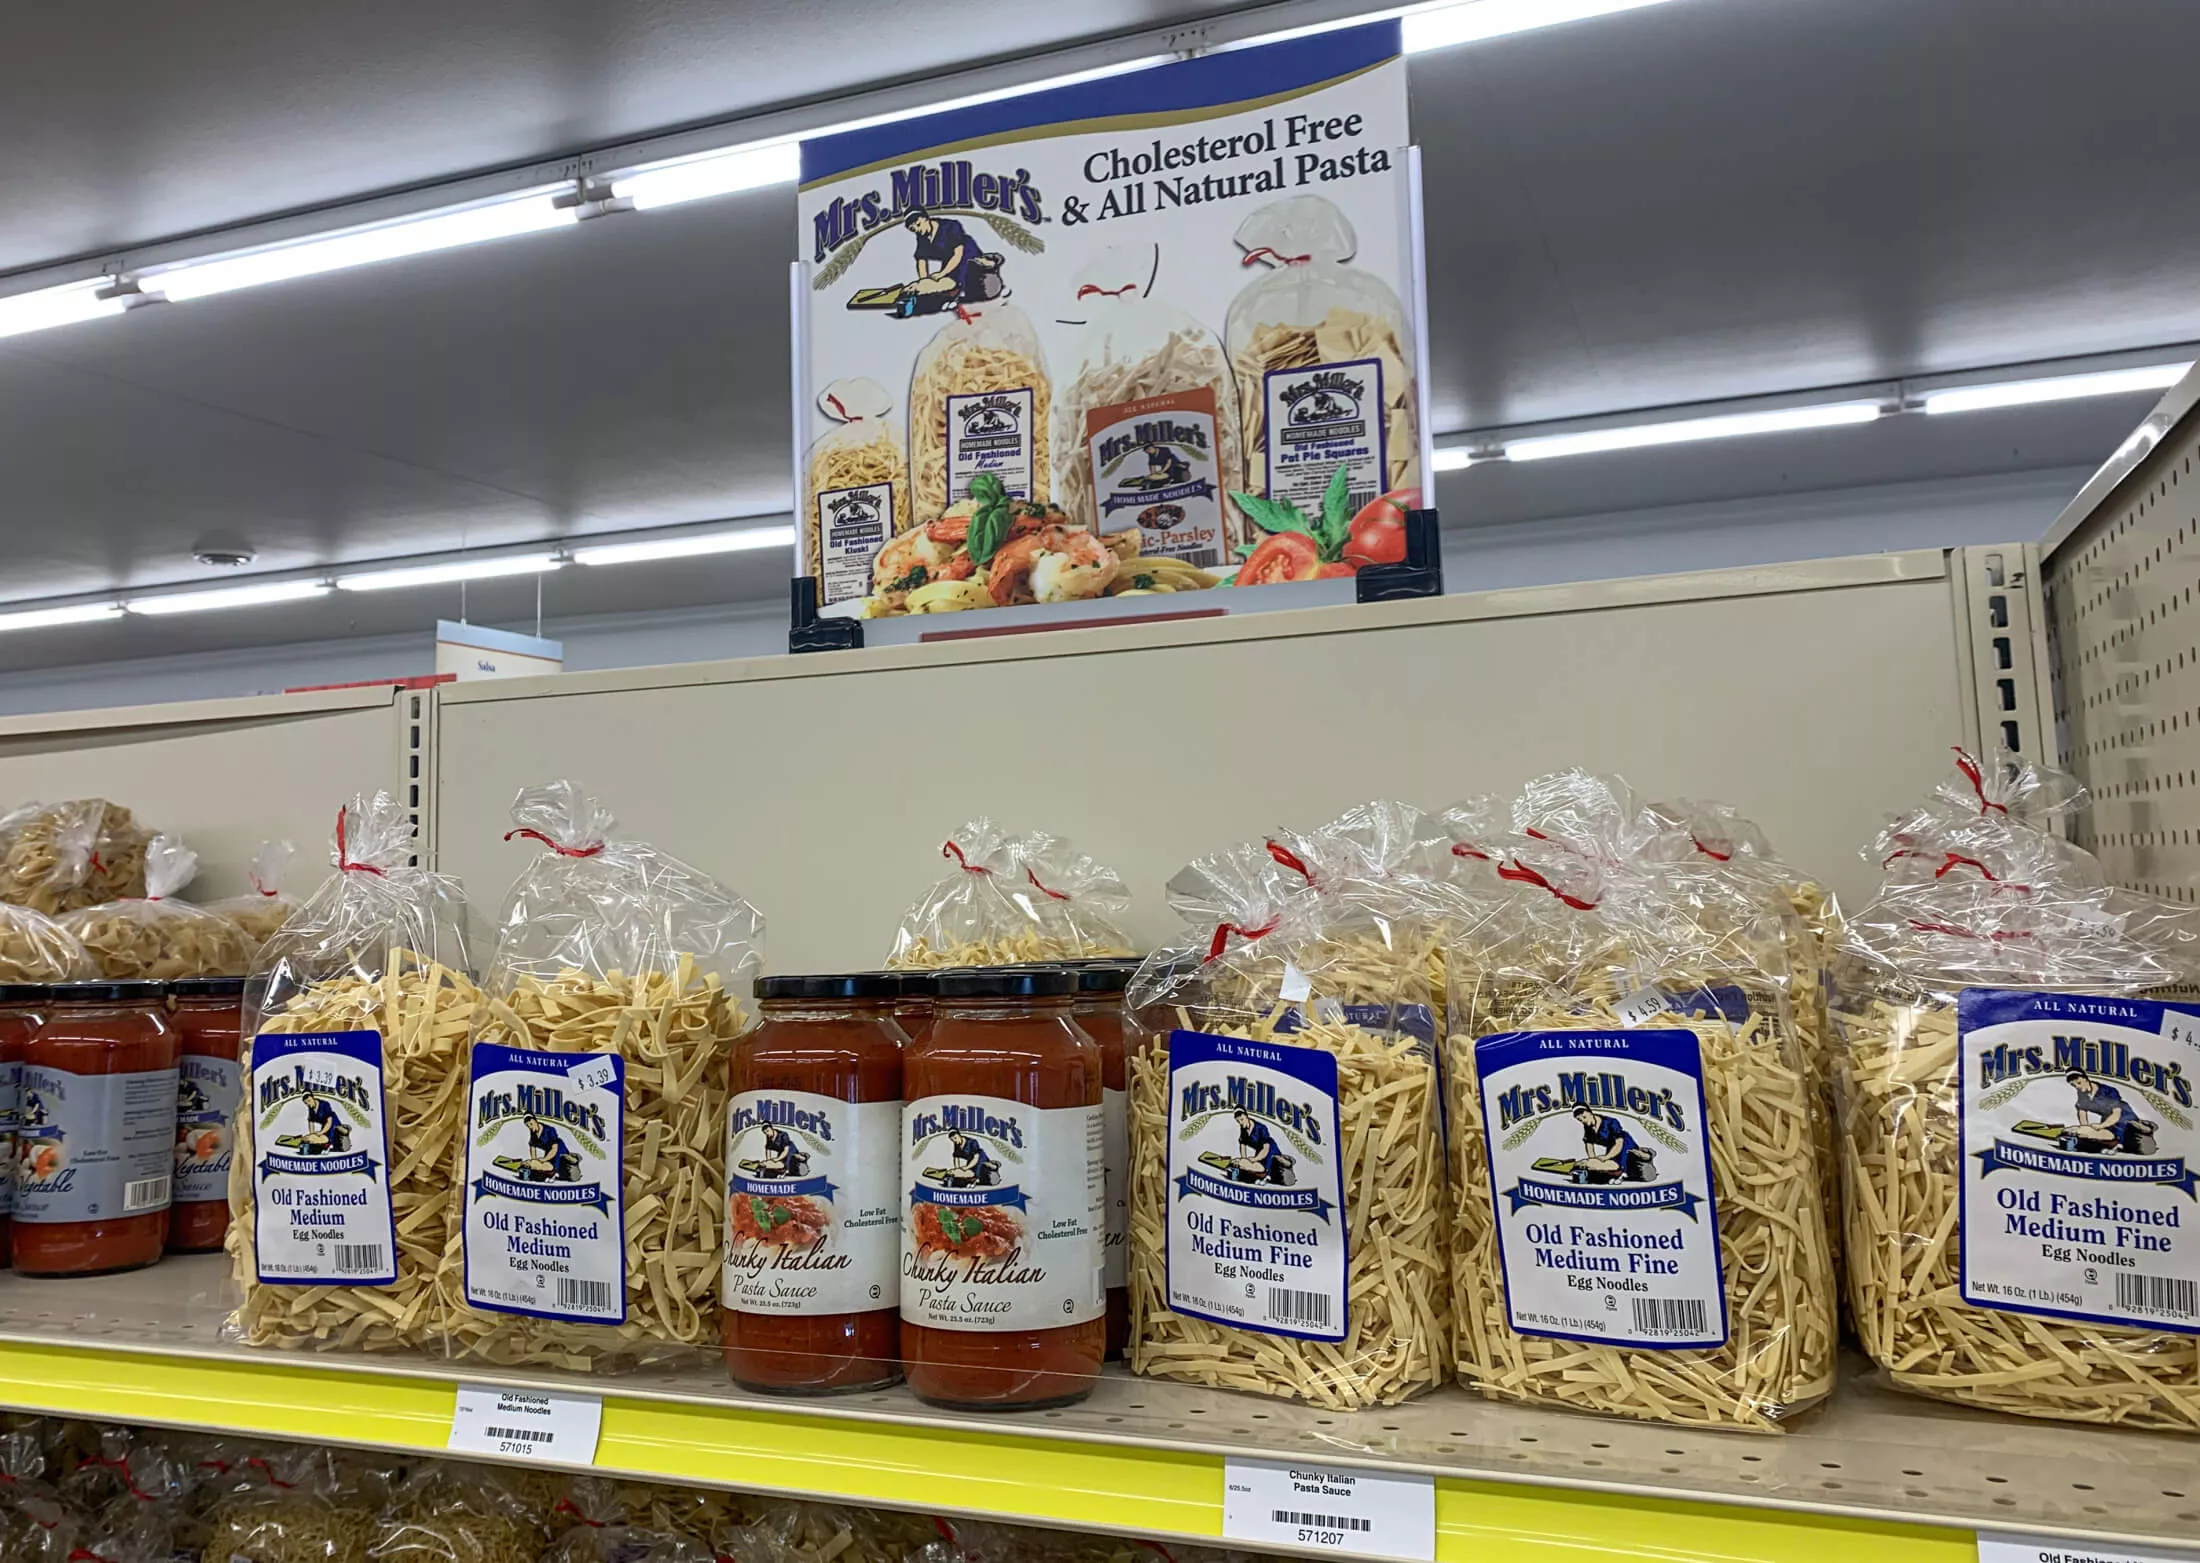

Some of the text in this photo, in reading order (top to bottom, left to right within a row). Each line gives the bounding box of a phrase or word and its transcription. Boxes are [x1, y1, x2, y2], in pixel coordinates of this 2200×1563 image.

[1084, 113, 1363, 183] Cholesterol Free
[1062, 146, 1392, 226] & All Natural Pasta
[959, 448, 1021, 461] Old Fashioned
[1281, 448, 1368, 463] Pot Pie Squares
[830, 540, 841, 548] Old
[845, 546, 868, 554] Kluski
[478, 660, 495, 672] Salsa
[1628, 997, 1661, 1022] $ 4.59
[2033, 1000, 2137, 1018] ALL NATURAL
[284, 1037, 338, 1047] ALL NATURAL
[1539, 1038, 1629, 1048] ALL NATURAL
[2172, 1027, 2179, 1041] $
[509, 1054, 569, 1068] ALL NATURAL
[1217, 1043, 1282, 1061] ALL NATURAL
[578, 1068, 609, 1091] $ 3.39
[1979, 1035, 2192, 1109] Mrs. Miller's
[1498, 1072, 1686, 1132] Mrs. Miller's
[757, 1100, 832, 1141] Miller's
[942, 1105, 1023, 1148] Miller's
[269, 1155, 364, 1172] HOMEMADE NOODLES
[2000, 1146, 2177, 1178] HOMEMADE NOODLES
[272, 1189, 366, 1206] Old Fashioned
[486, 1176, 595, 1201] HOMEMADE NOODLES
[747, 1183, 797, 1194] HOMEMADE
[1189, 1172, 1313, 1206] HOMEMADE NOODLES
[1523, 1184, 1678, 1206] HOMEMADE NOODLES
[933, 1192, 988, 1204] HOMEMADE
[291, 1209, 344, 1225] Medium
[860, 1208, 886, 1217] Low Fat
[1997, 1188, 2180, 1228] Old Fashioned
[483, 1212, 598, 1240] Old Fashioned
[844, 1216, 898, 1228] Cholesterol Free
[1052, 1219, 1077, 1228] Low Fat
[1187, 1211, 1318, 1246] Old Fashioned
[293, 1229, 344, 1241] Egg Noodles
[1038, 1228, 1088, 1240] Cholesterol Free
[1526, 1224, 1684, 1250] Old Fashioned
[2004, 1215, 2172, 1252] Medium Fine
[507, 1235, 571, 1258] Medium
[723, 1231, 852, 1279] Chunky Italian
[1192, 1234, 1312, 1268] Medium Fine
[2041, 1244, 2135, 1267] Egg Noodles
[510, 1257, 569, 1273] Egg Noodles
[903, 1241, 1047, 1292] Chunky Italian
[1535, 1248, 1679, 1274] Medium Fine
[1214, 1263, 1284, 1282] Egg Noodles
[733, 1275, 817, 1297] Pasta Sauce
[1568, 1275, 1648, 1292] Egg Noodles
[919, 1288, 1012, 1313] Pasta Sauce
[1972, 1281, 2082, 1306] Net Wt. 16 Oz. (1 Lb.) (454g)
[1516, 1312, 1526, 1321] Net
[1527, 1313, 1539, 1323] Wt.
[1540, 1315, 1549, 1323] 16
[1584, 1319, 1606, 1332] (454g)
[2159, 1307, 2189, 1319] 25042
[502, 1393, 549, 1405] Old Fashioned
[497, 1403, 551, 1415] Medium Noodles
[500, 1442, 532, 1454] 571015
[1289, 1471, 1355, 1485] Chunky Italian
[1294, 1483, 1351, 1496] Pasta Sauce
[1298, 1530, 1344, 1544] 571207
[2039, 1552, 2060, 1563] Old
